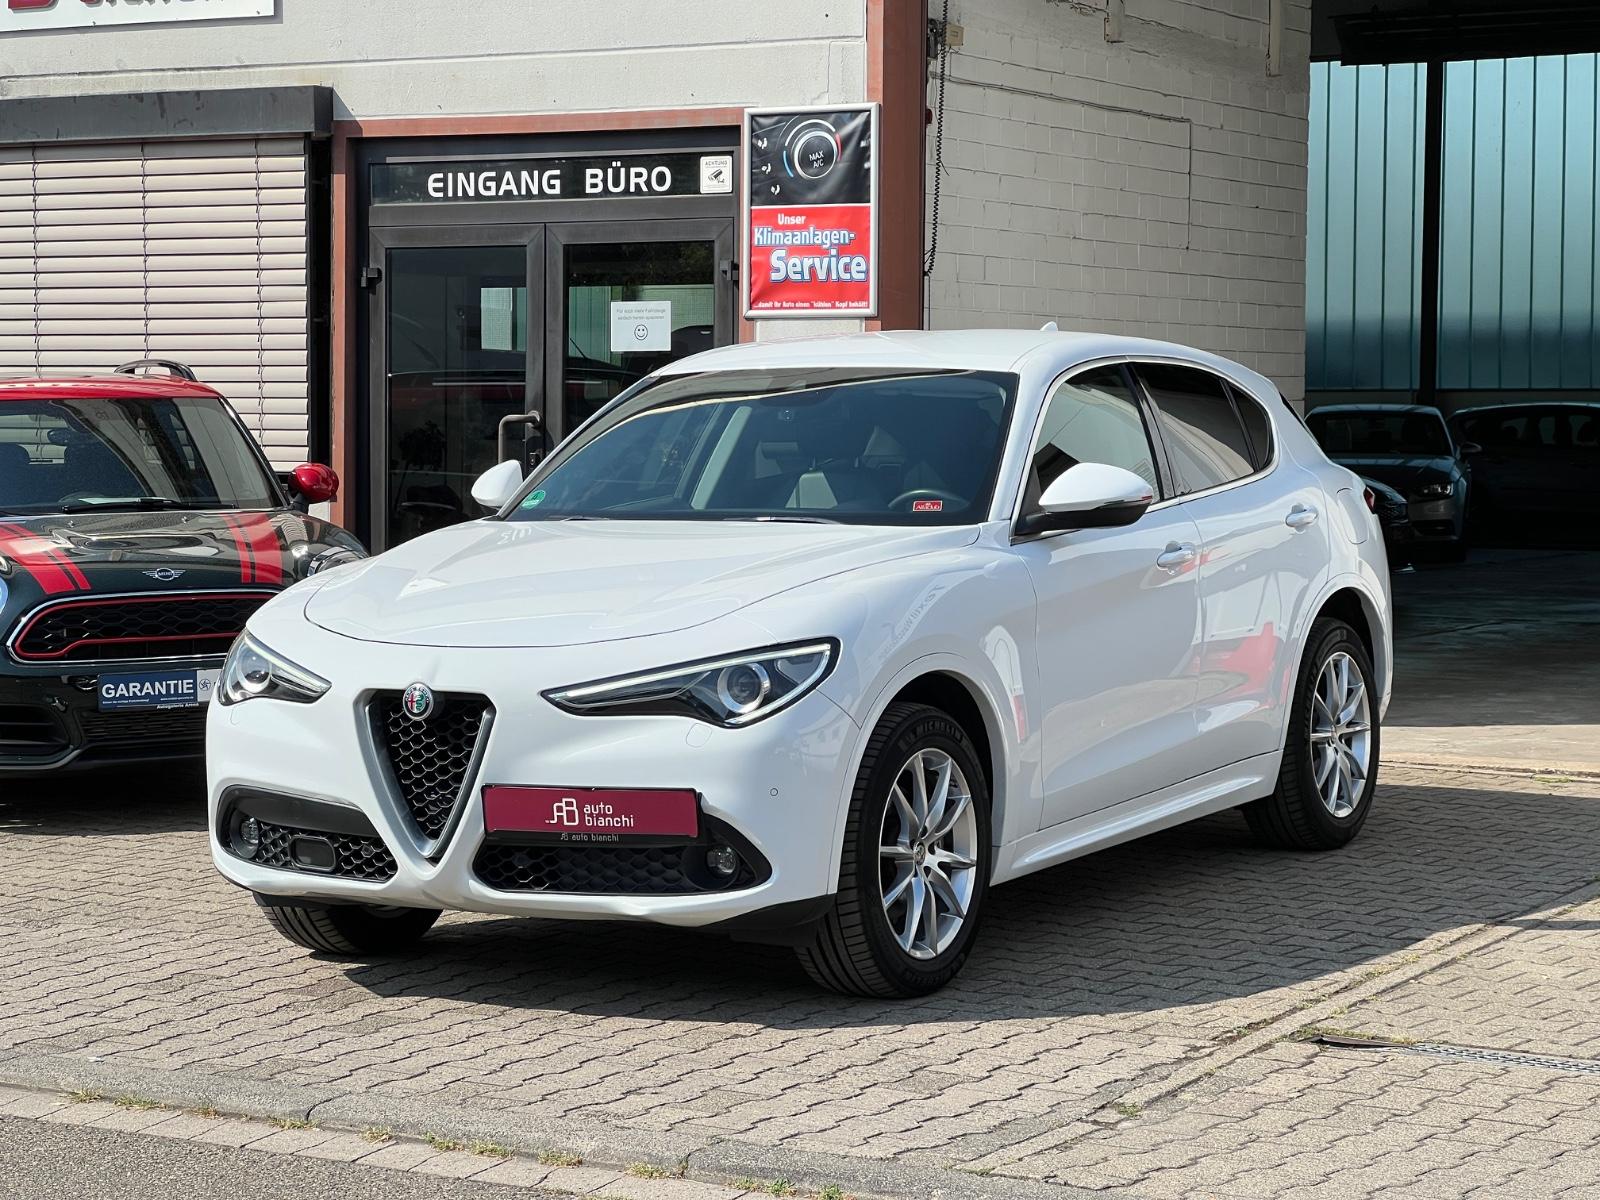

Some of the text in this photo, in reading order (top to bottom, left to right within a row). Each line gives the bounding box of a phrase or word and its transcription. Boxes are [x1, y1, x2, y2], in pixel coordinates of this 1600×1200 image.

[809, 151, 824, 161] MAX
[813, 159, 824, 169] A/C
[427, 161, 672, 197] EINGANG BÜRO
[777, 213, 806, 225] Unser
[754, 226, 856, 249] Klimaanlagen-
[769, 248, 868, 282] Service
[101, 679, 194, 698] GARANTIE
[583, 801, 613, 815] auto
[585, 814, 635, 827] bianchi
[571, 833, 589, 841] auto
[591, 833, 620, 842] bianchi
